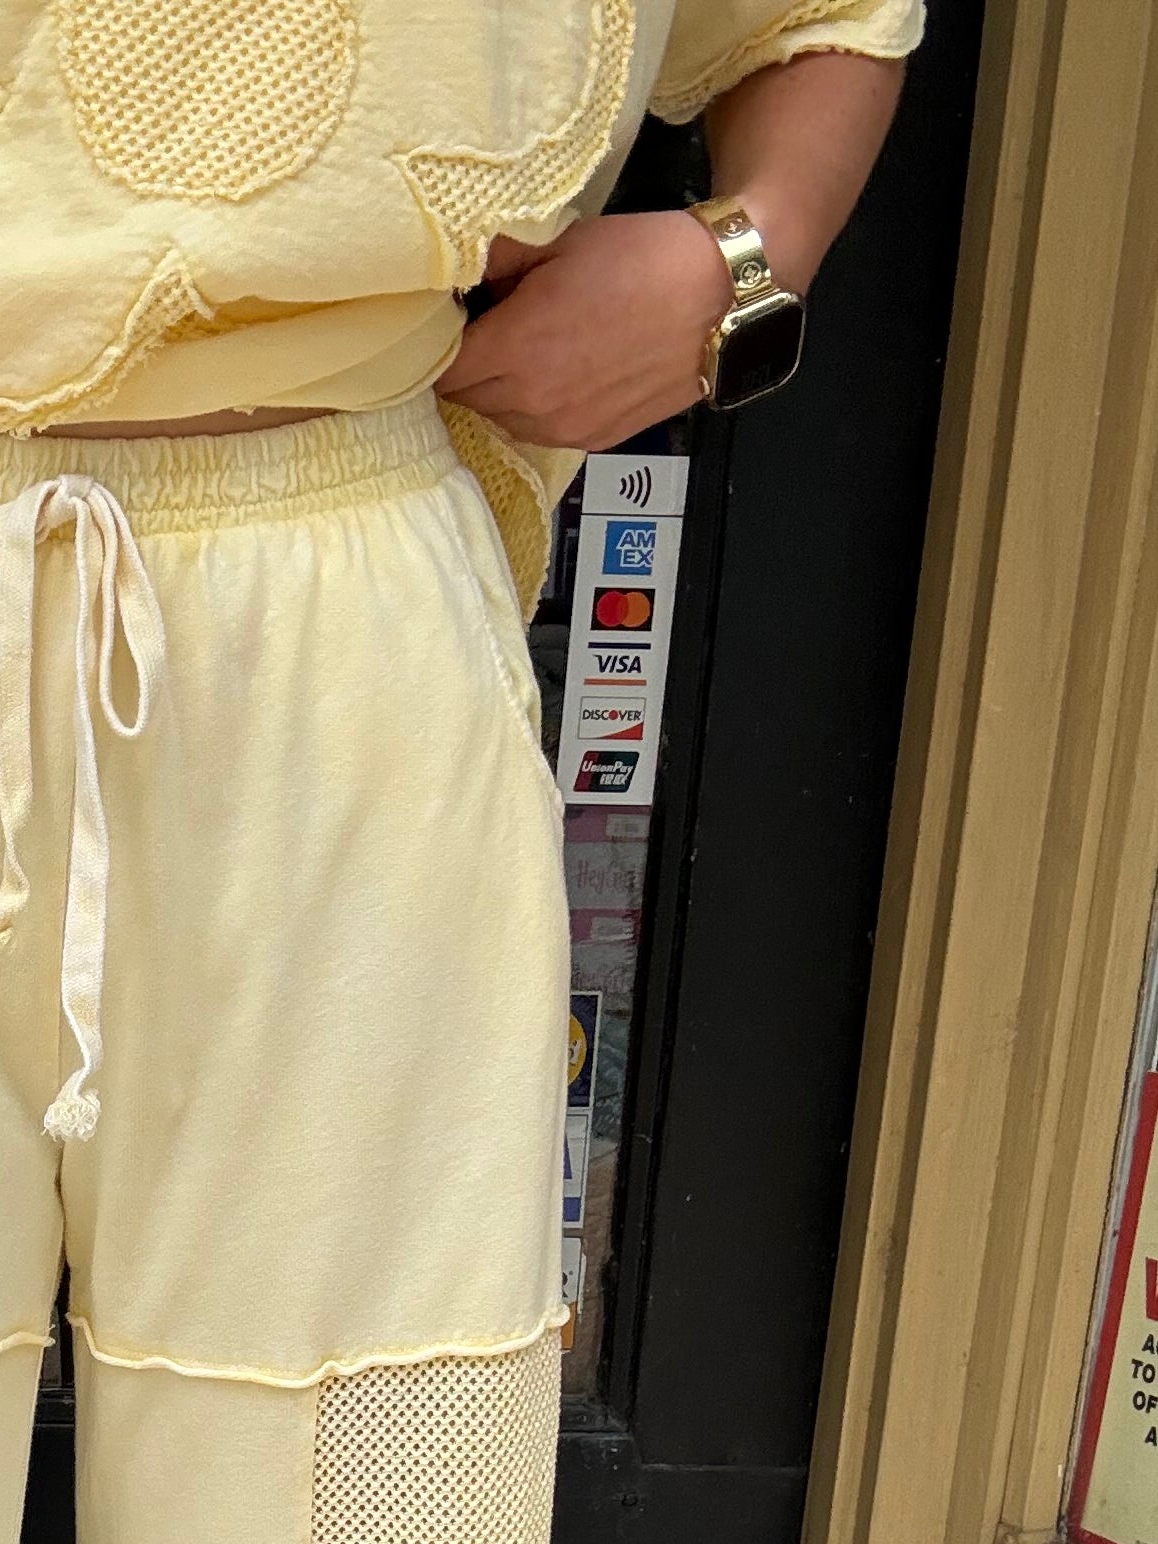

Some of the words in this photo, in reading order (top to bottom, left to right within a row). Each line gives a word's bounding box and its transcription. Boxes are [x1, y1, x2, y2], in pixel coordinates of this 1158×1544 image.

[618, 530, 657, 548] AM
[621, 548, 655, 566] EX
[593, 654, 643, 674] VISA
[582, 708, 642, 723] DISCOVER
[581, 760, 634, 778] UnionPay
